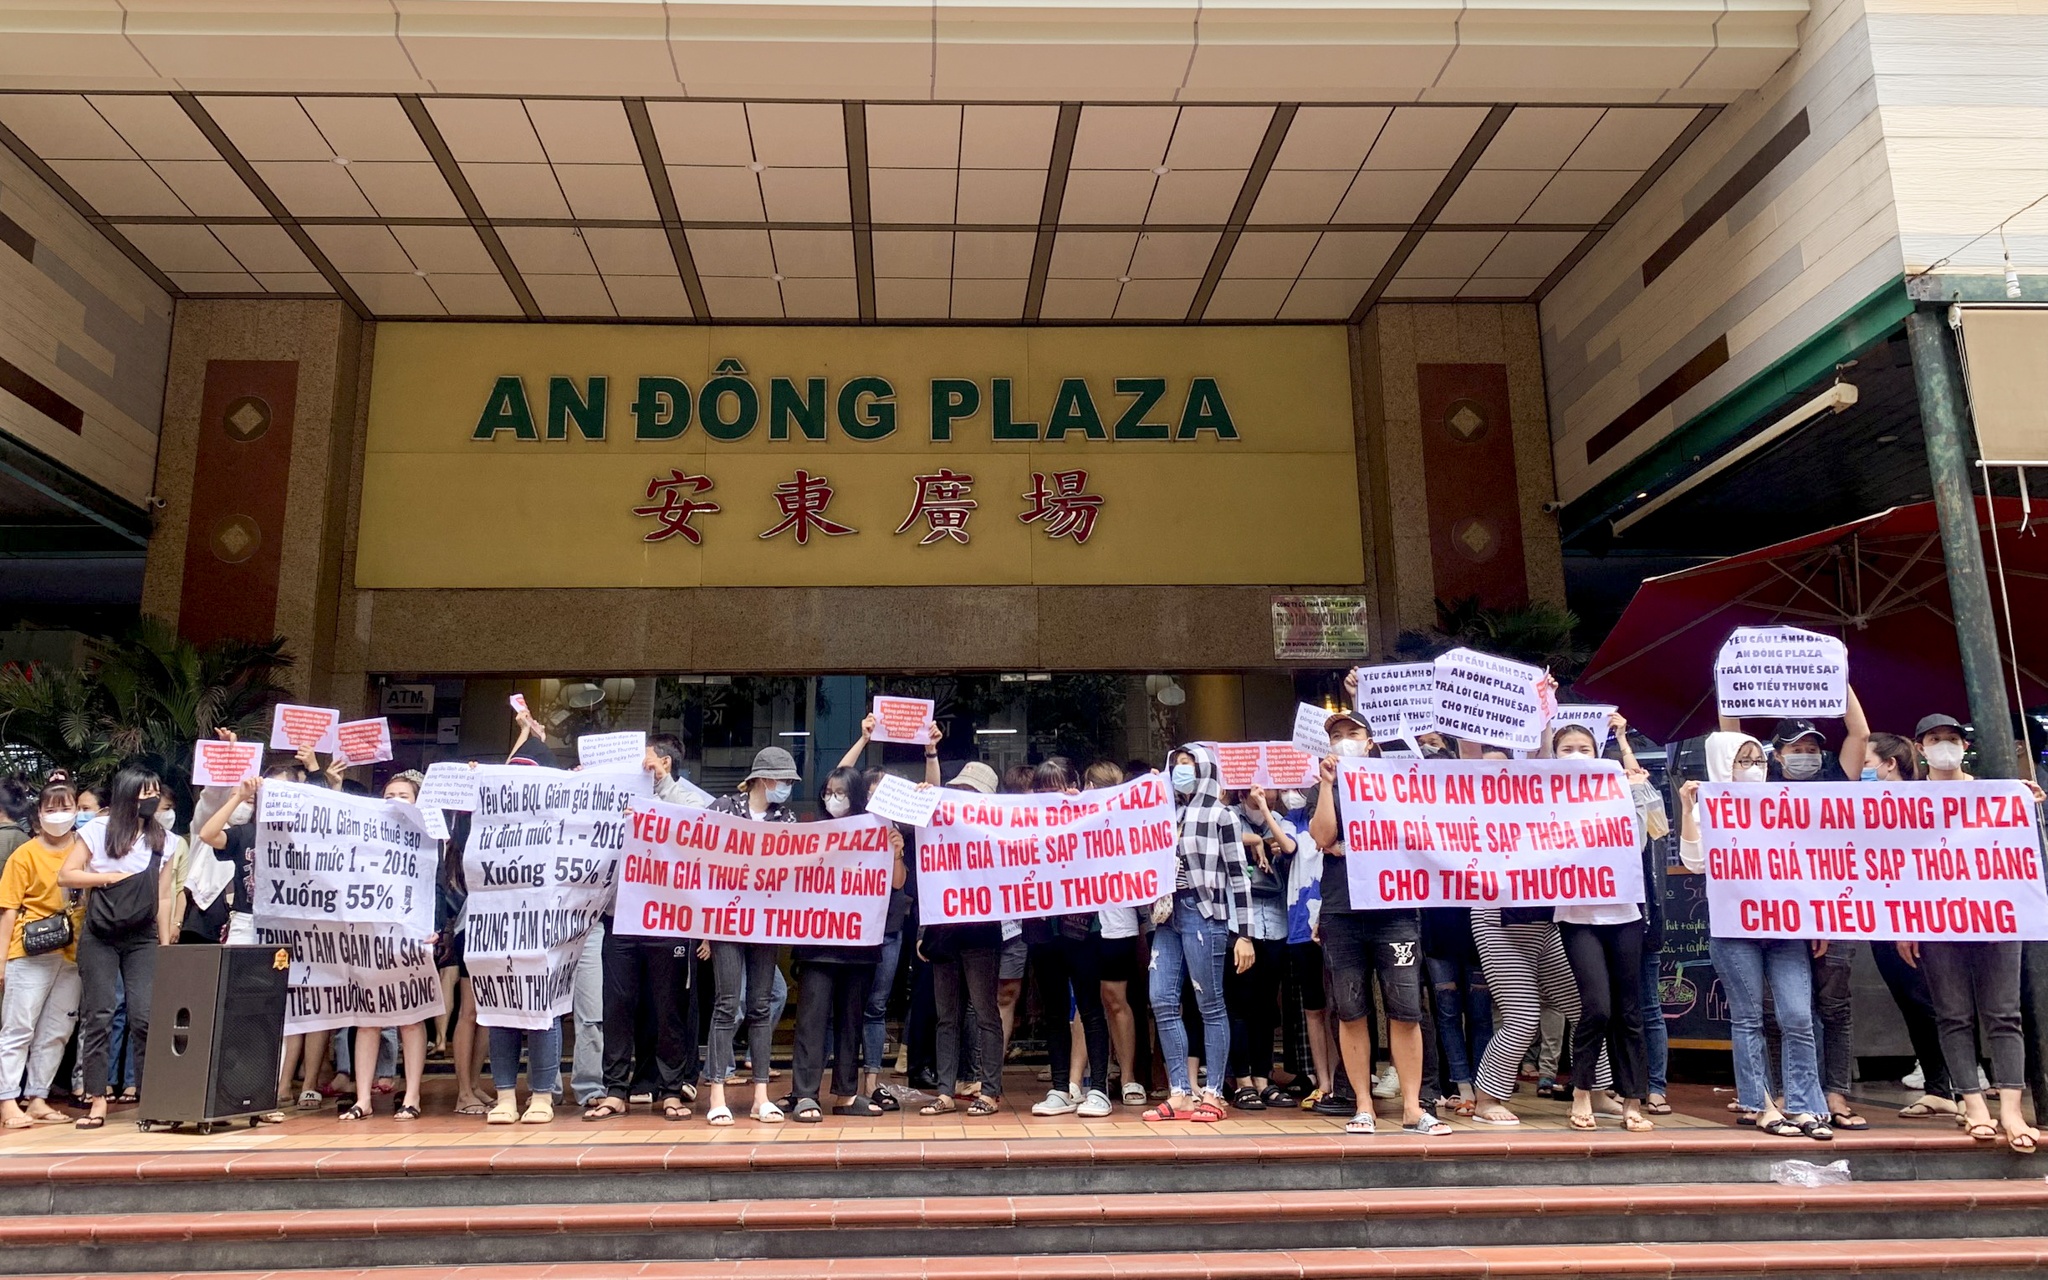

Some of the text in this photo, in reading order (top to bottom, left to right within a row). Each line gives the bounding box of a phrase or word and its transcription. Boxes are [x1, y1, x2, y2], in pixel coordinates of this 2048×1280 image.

[471, 359, 1240, 442] AN ĐÔNG PLAZA
[1735, 648, 1823, 659] AN ĐÔNG PLAZA
[1763, 664, 1784, 674] GIÁ
[1785, 664, 1815, 674] THUÊ
[1816, 664, 1840, 676] SẠP
[387, 690, 424, 704] ATM
[1371, 687, 1382, 695] AN
[1409, 684, 1433, 692] PLAZ
[1435, 680, 1454, 693] TRẢ
[1473, 691, 1490, 702] GIÁ
[1516, 703, 1537, 715] SẠP
[1451, 667, 1525, 695] AN ĐÔNG PLAZA
[1733, 681, 1754, 691] CHO
[1370, 714, 1387, 723] CHO
[1441, 700, 1462, 711] CHO
[1721, 697, 1843, 708] TRONG NGÀY HÔM NAY
[1515, 734, 1538, 743] NAY
[479, 780, 613, 816] Yêu Cầu BQL Giảm giá thuê
[1344, 763, 1625, 805] YÊU CẦU AN ĐÔNG PLAZA
[932, 799, 955, 827] ÊU
[1010, 807, 1040, 828] AN
[1705, 787, 2030, 829] YÊU CẦU AN ĐÔNG PLAZA
[310, 806, 332, 839] BQL
[336, 809, 361, 836] Giảm
[363, 818, 378, 842] giá
[380, 817, 401, 844] thuê
[404, 830, 421, 851] sạp
[479, 825, 494, 850] từ
[496, 823, 522, 854] định
[526, 820, 552, 846] mức
[632, 808, 888, 857] YÊU CẦU AN ĐÔNG PLAZA
[920, 818, 1173, 873] GIẢM GIÁ THUÊ SẠP THỎA ĐÁNG
[1348, 809, 1634, 859] GIẢM GIÁ THUÊ SẠP THỎA ĐÁNG
[267, 842, 283, 869] từ
[285, 844, 310, 877] định
[315, 845, 345, 872] mức
[481, 855, 600, 887] Xuống 55%
[625, 849, 886, 898] GIẢM GIÁ THUÊ SẠP THỎA ĐÁNG
[1378, 857, 1617, 901] CHO TIỂU THƯƠNG
[1709, 837, 2038, 888] GIẢM GIÁ THUÊ SẠP THỎA ĐÁNG
[270, 880, 394, 913] Xuống 55%
[943, 869, 1158, 917] CHO TIỂU THƯƠNG
[1739, 886, 2017, 934] CHO TIỂU THƯƠNG
[467, 912, 508, 952] TRUNG
[513, 900, 539, 950] TÂM
[642, 895, 862, 940] CHO TIỂU THƯƠNG
[305, 924, 337, 964] TÂM
[375, 926, 397, 971] GIÁ
[400, 936, 427, 971] SẠP
[287, 966, 321, 1017] TIỂU
[379, 983, 397, 1013] AN
[400, 974, 436, 1010] ĐÔNG
[472, 975, 498, 1007] CHO
[496, 955, 523, 1010] TIỂU
